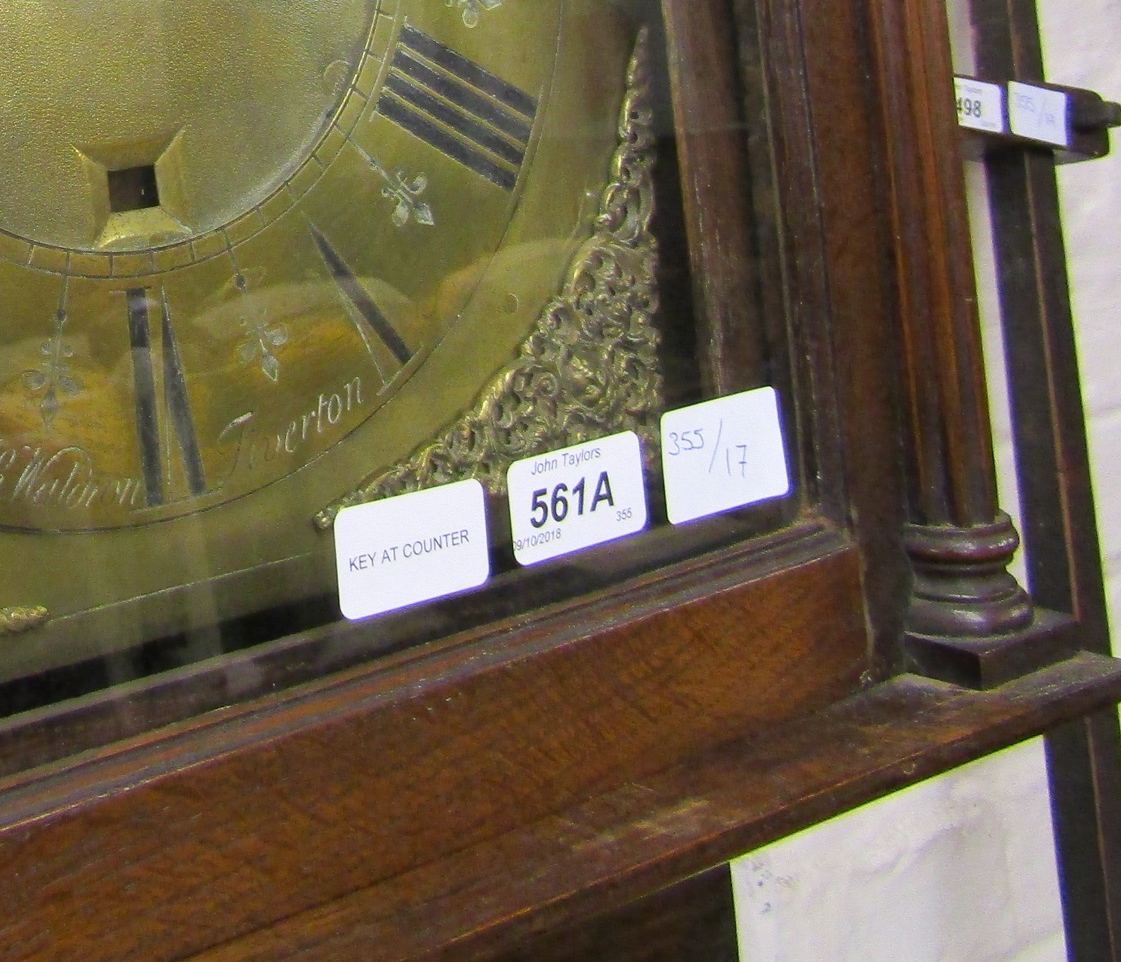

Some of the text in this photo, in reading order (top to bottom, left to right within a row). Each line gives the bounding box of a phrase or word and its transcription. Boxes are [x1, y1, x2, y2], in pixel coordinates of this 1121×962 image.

[531, 447, 601, 476] John Taylors
[530, 470, 614, 528] 561A
[616, 507, 632, 522] 355
[349, 529, 470, 572] KEY AT COUNTER
